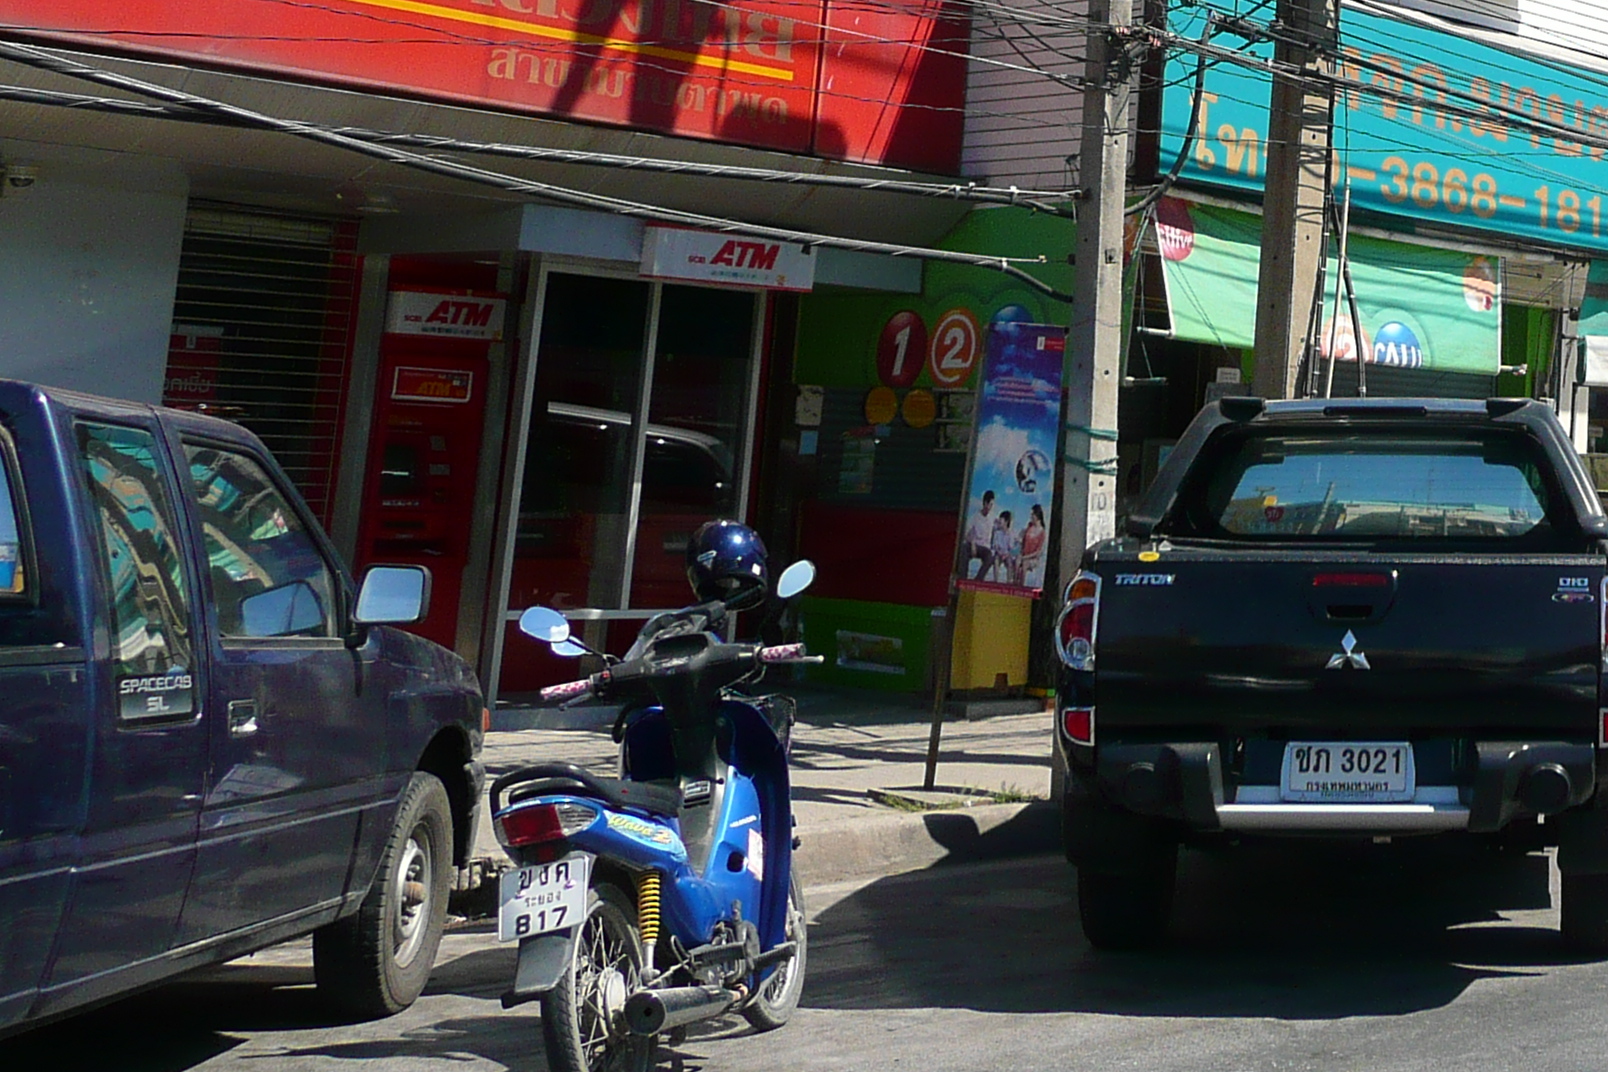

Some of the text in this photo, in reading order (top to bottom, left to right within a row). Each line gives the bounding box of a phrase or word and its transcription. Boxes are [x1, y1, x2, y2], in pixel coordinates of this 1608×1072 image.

[709, 239, 781, 271] ATM
[425, 299, 494, 328] ATM
[890, 325, 966, 376] 1 2
[1114, 573, 1177, 585] TRITON
[118, 674, 193, 694] SPACECAB
[1340, 748, 1402, 774] 3021
[607, 813, 653, 837] Wave
[524, 891, 562, 908] ระยอง
[515, 905, 568, 936] 817
